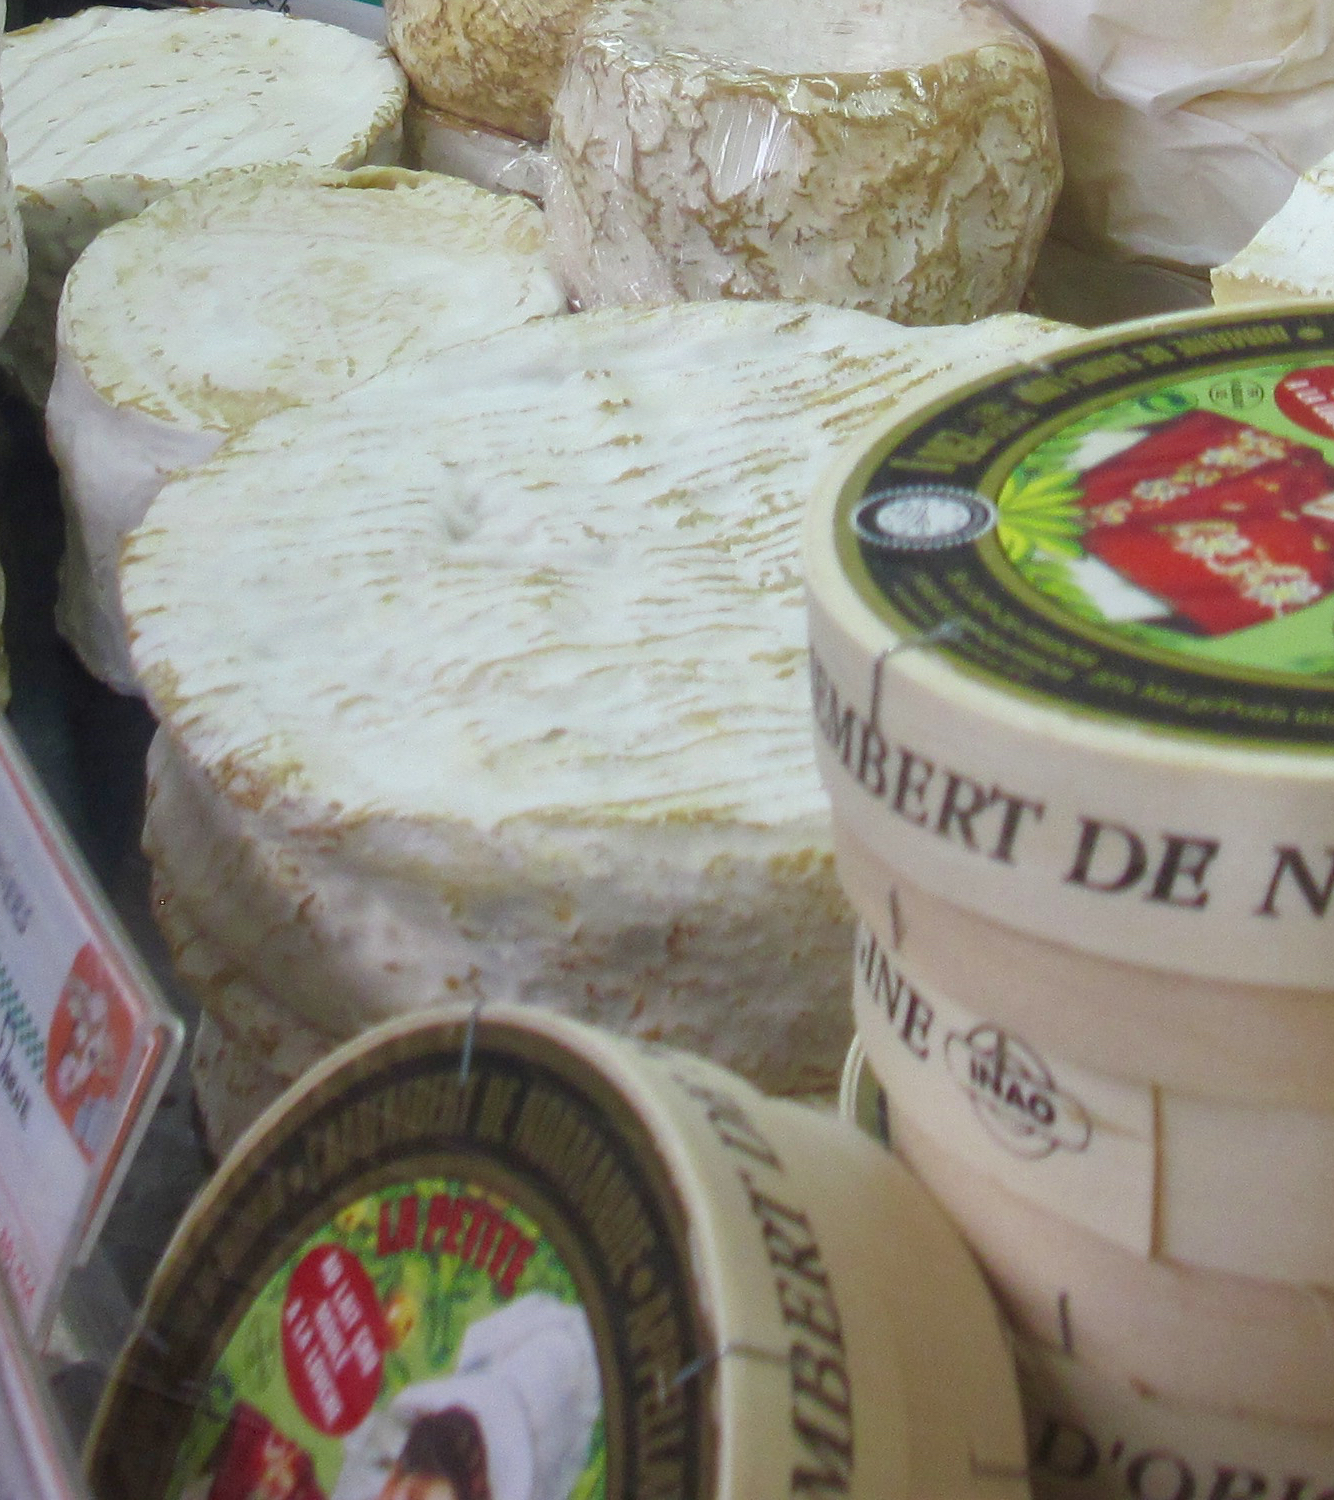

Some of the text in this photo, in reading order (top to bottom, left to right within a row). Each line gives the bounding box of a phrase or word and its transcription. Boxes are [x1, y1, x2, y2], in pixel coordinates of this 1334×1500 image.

[1063, 815, 1220, 910] DE
[970, 1055, 1056, 1127] INAO
[375, 1193, 419, 1258] LA
